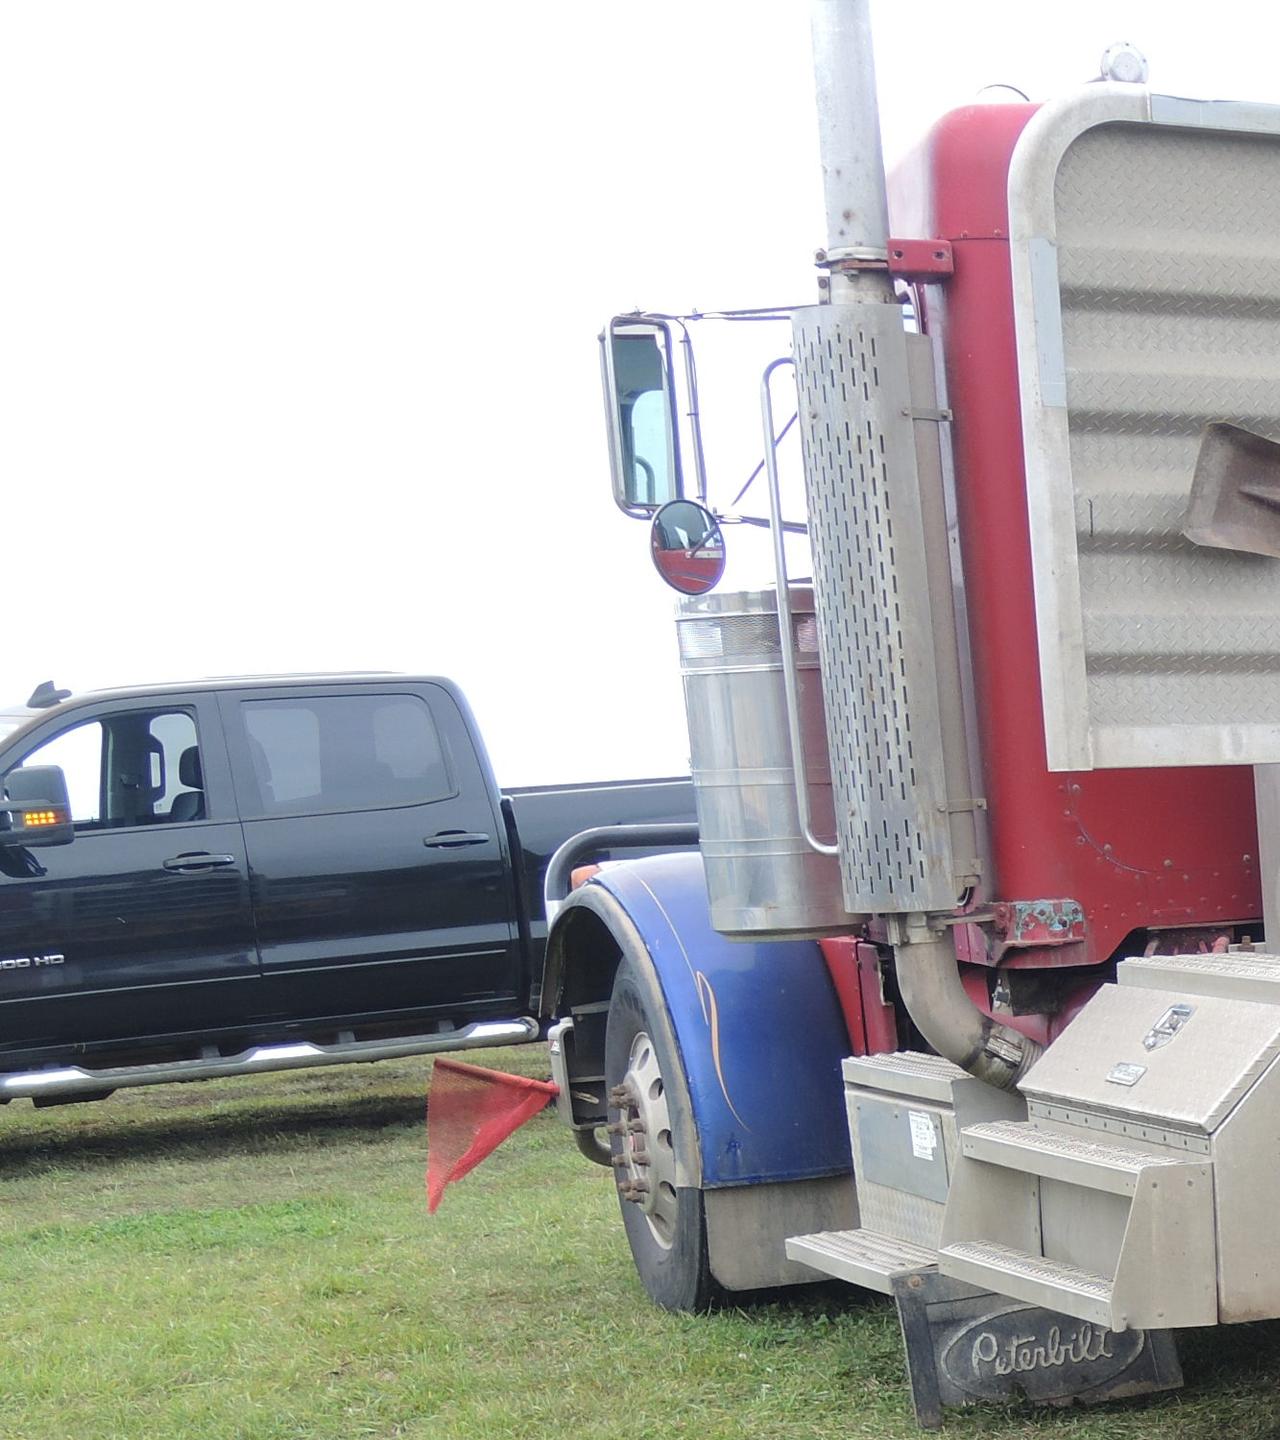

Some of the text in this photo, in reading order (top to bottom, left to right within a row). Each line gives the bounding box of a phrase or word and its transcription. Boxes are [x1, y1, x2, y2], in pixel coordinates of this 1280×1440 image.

[0, 954, 65, 970] 00 HD
[972, 1324, 1114, 1377] Peterbilt
